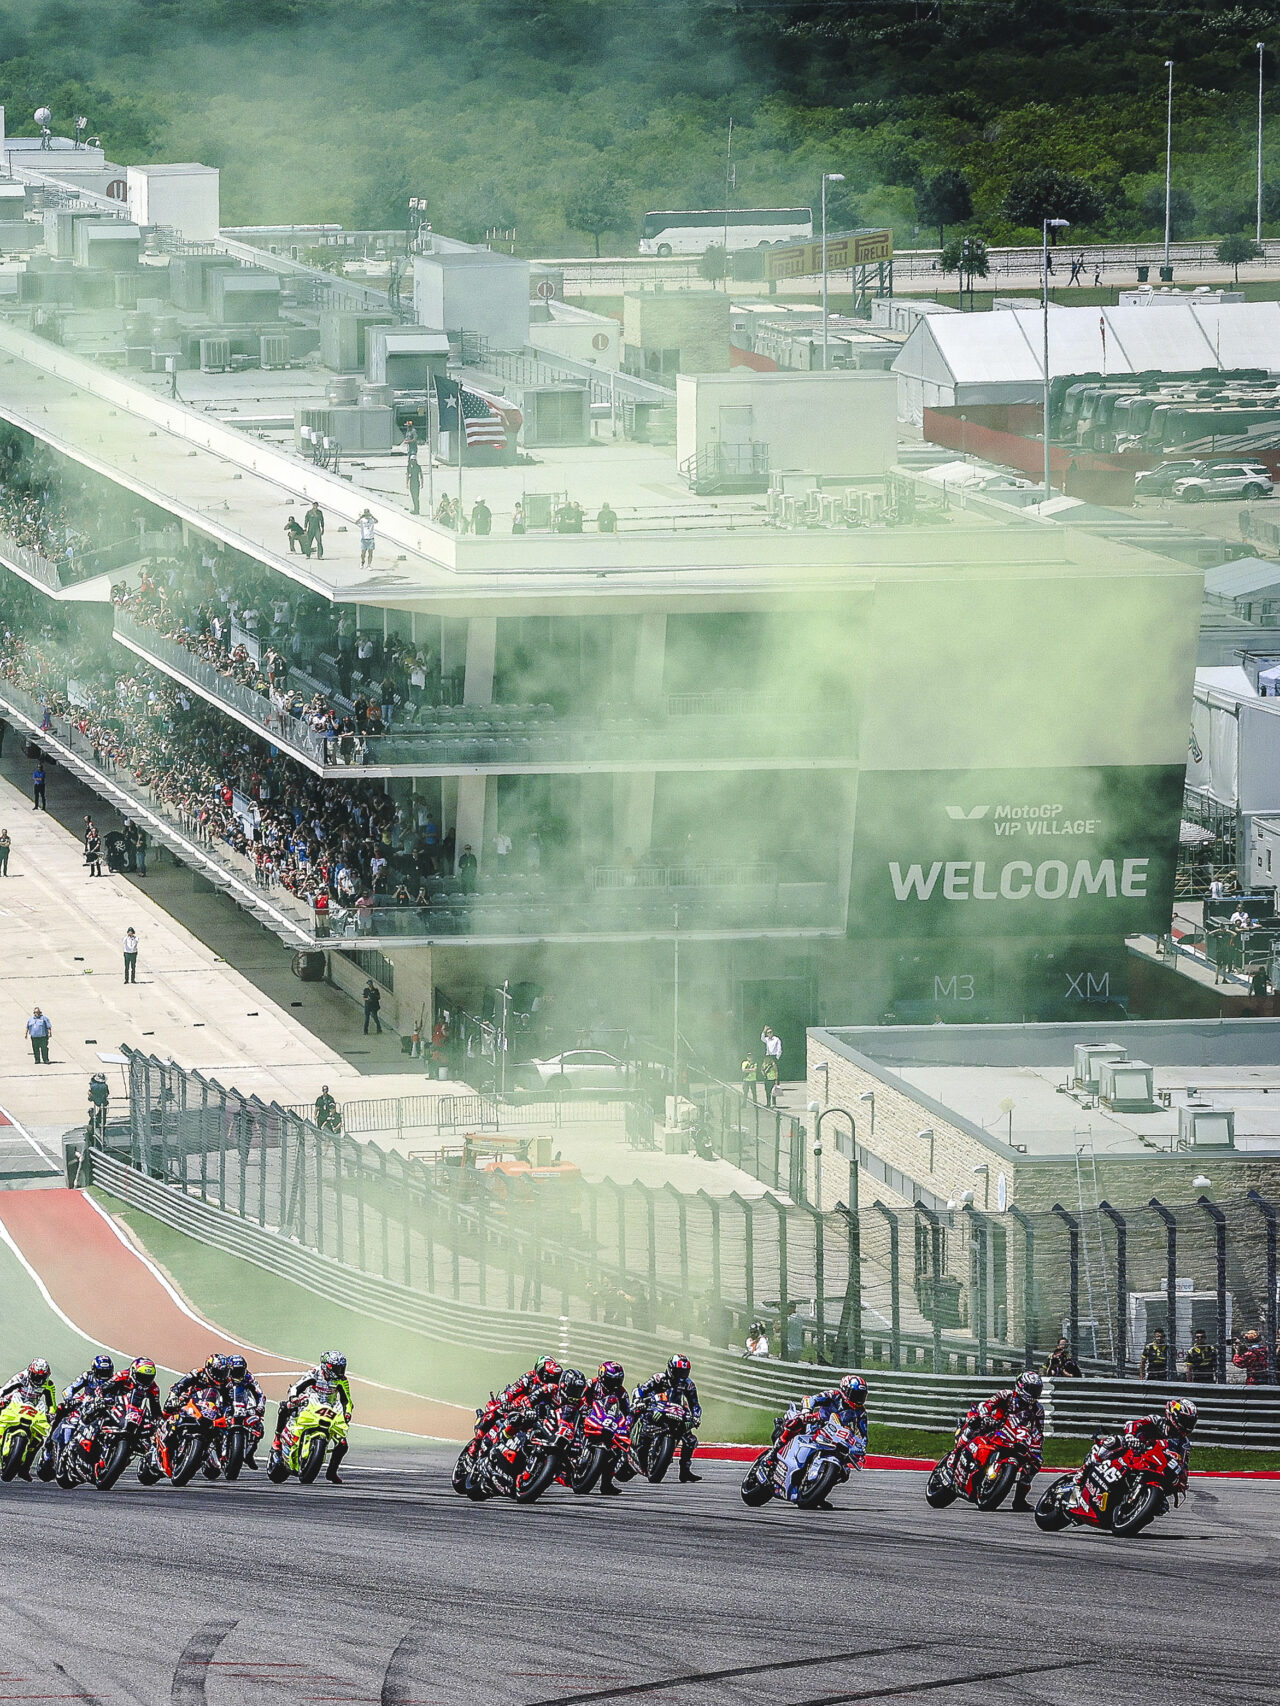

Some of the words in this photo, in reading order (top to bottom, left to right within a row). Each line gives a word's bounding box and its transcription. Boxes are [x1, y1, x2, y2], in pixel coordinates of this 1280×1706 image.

[812, 240, 849, 271] PIELLI
[854, 233, 890, 263] PIRELLI
[994, 804, 1063, 819] MotoGP
[994, 822, 1021, 835] VIP
[888, 858, 1150, 900] WELCOME
[934, 974, 975, 1001] M3
[1065, 972, 1110, 998] XM
[19, 1405, 38, 1417] 72
[315, 1407, 338, 1420] 49
[602, 1417, 618, 1431] 89
[836, 1429, 856, 1446] 93
